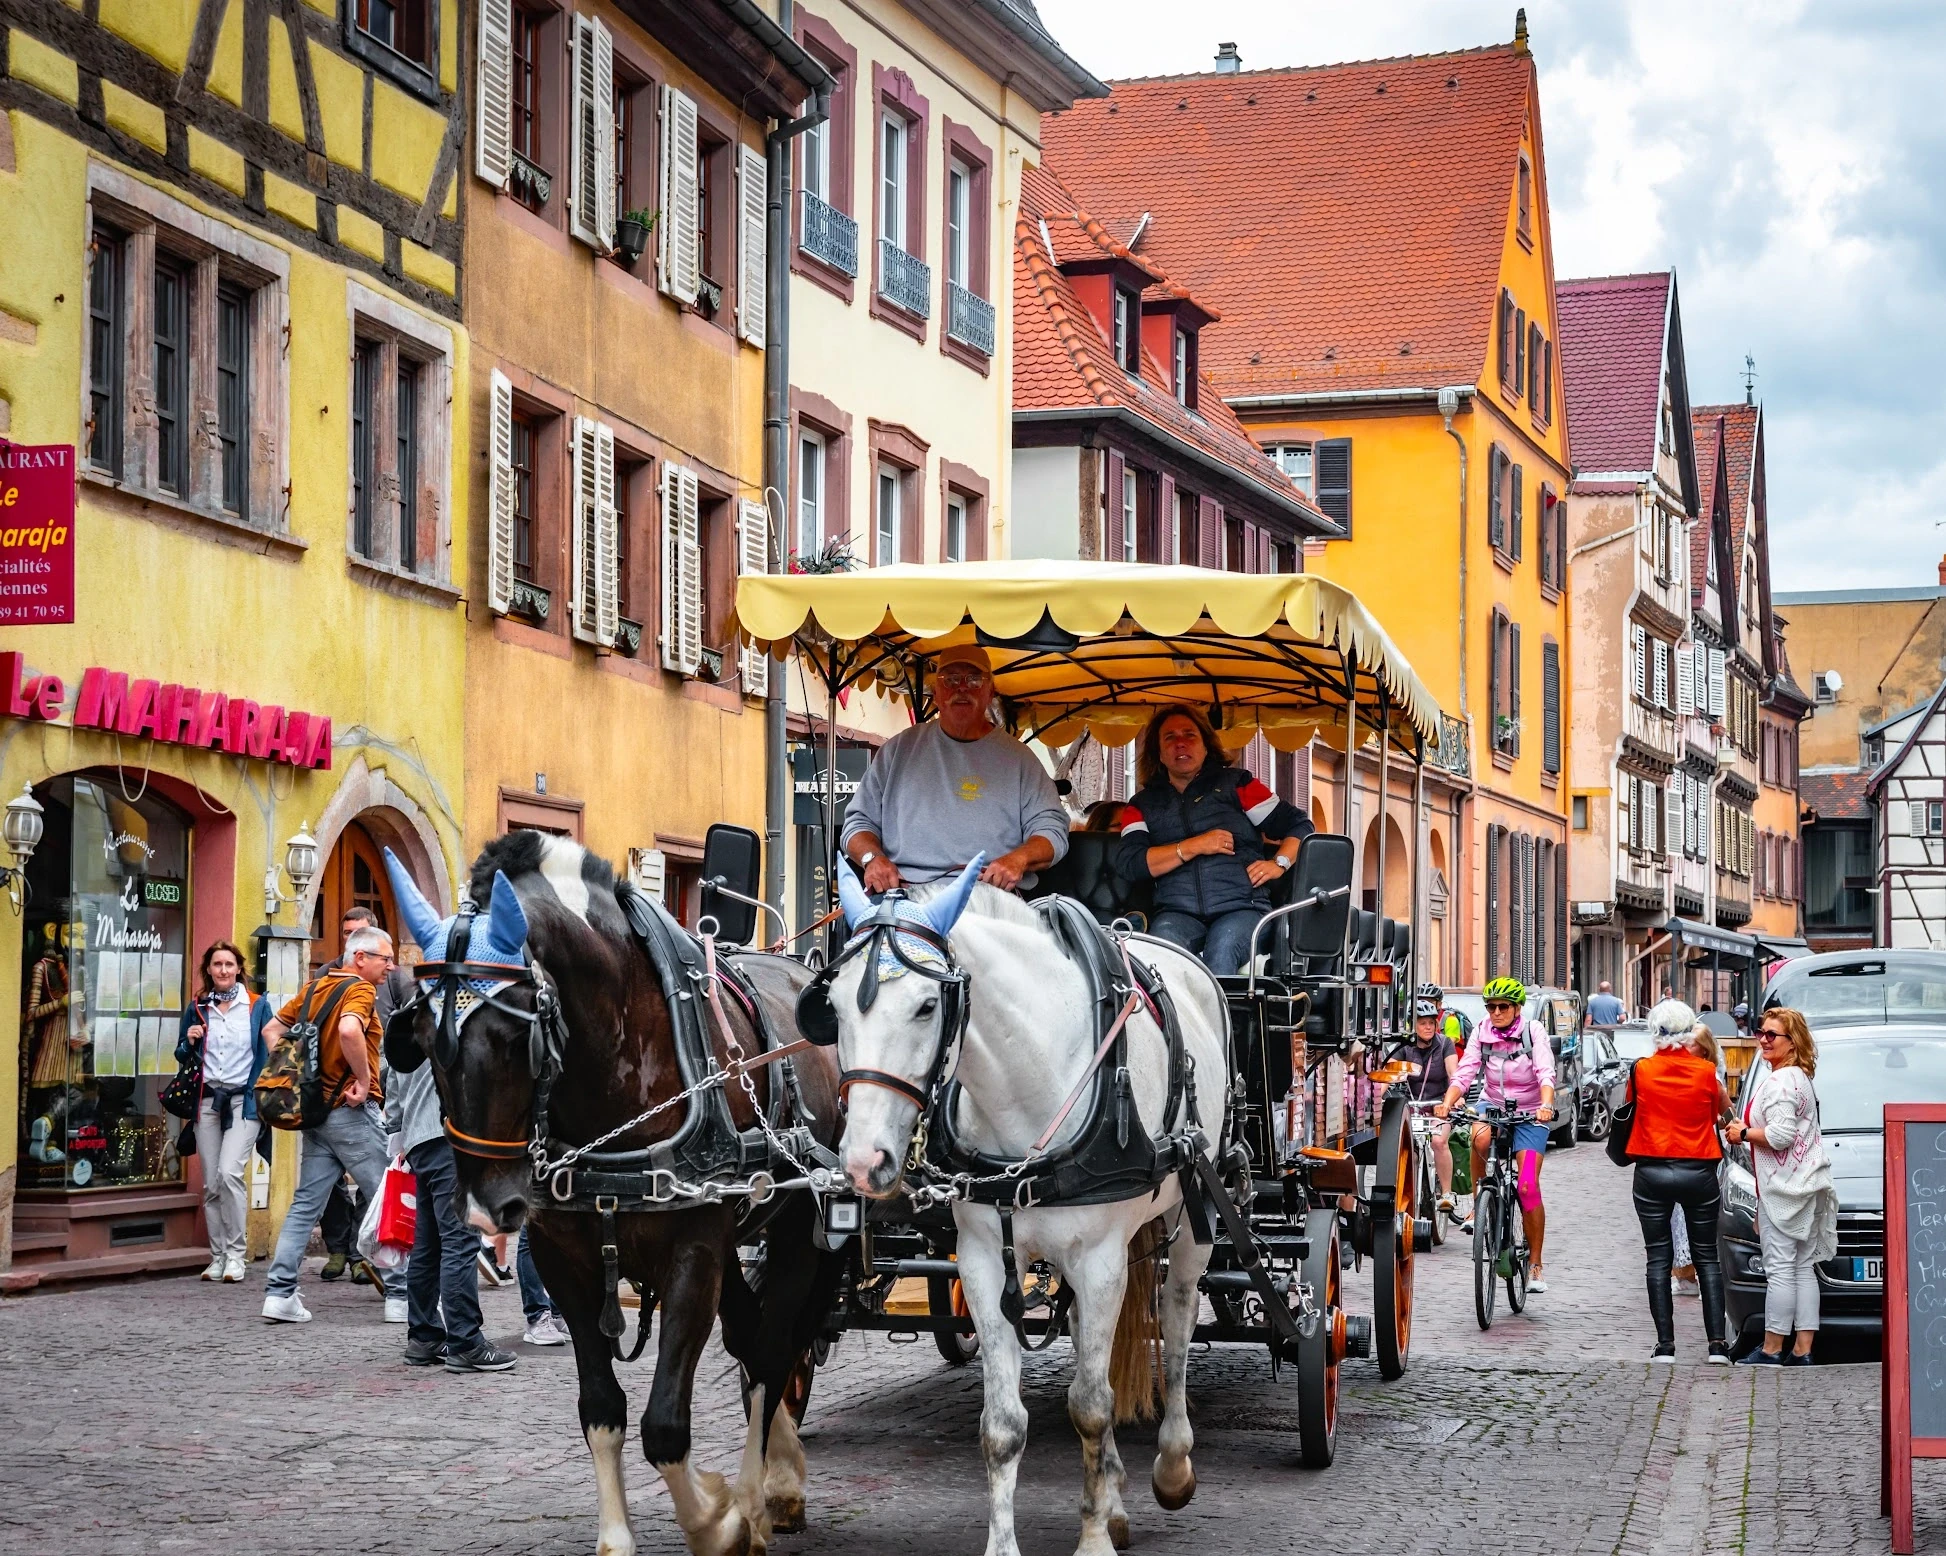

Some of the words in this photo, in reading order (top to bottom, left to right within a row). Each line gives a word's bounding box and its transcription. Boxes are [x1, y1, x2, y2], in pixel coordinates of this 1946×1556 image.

[15, 607, 28, 618] 41
[33, 606, 47, 617] 70
[50, 605, 65, 617] 95
[0, 651, 65, 721] Le
[74, 667, 332, 770] MAHARAJA
[103, 830, 156, 859] Restaurant
[120, 876, 140, 911] Le
[145, 882, 180, 903] CLOSED
[95, 912, 162, 961] Maharaja
